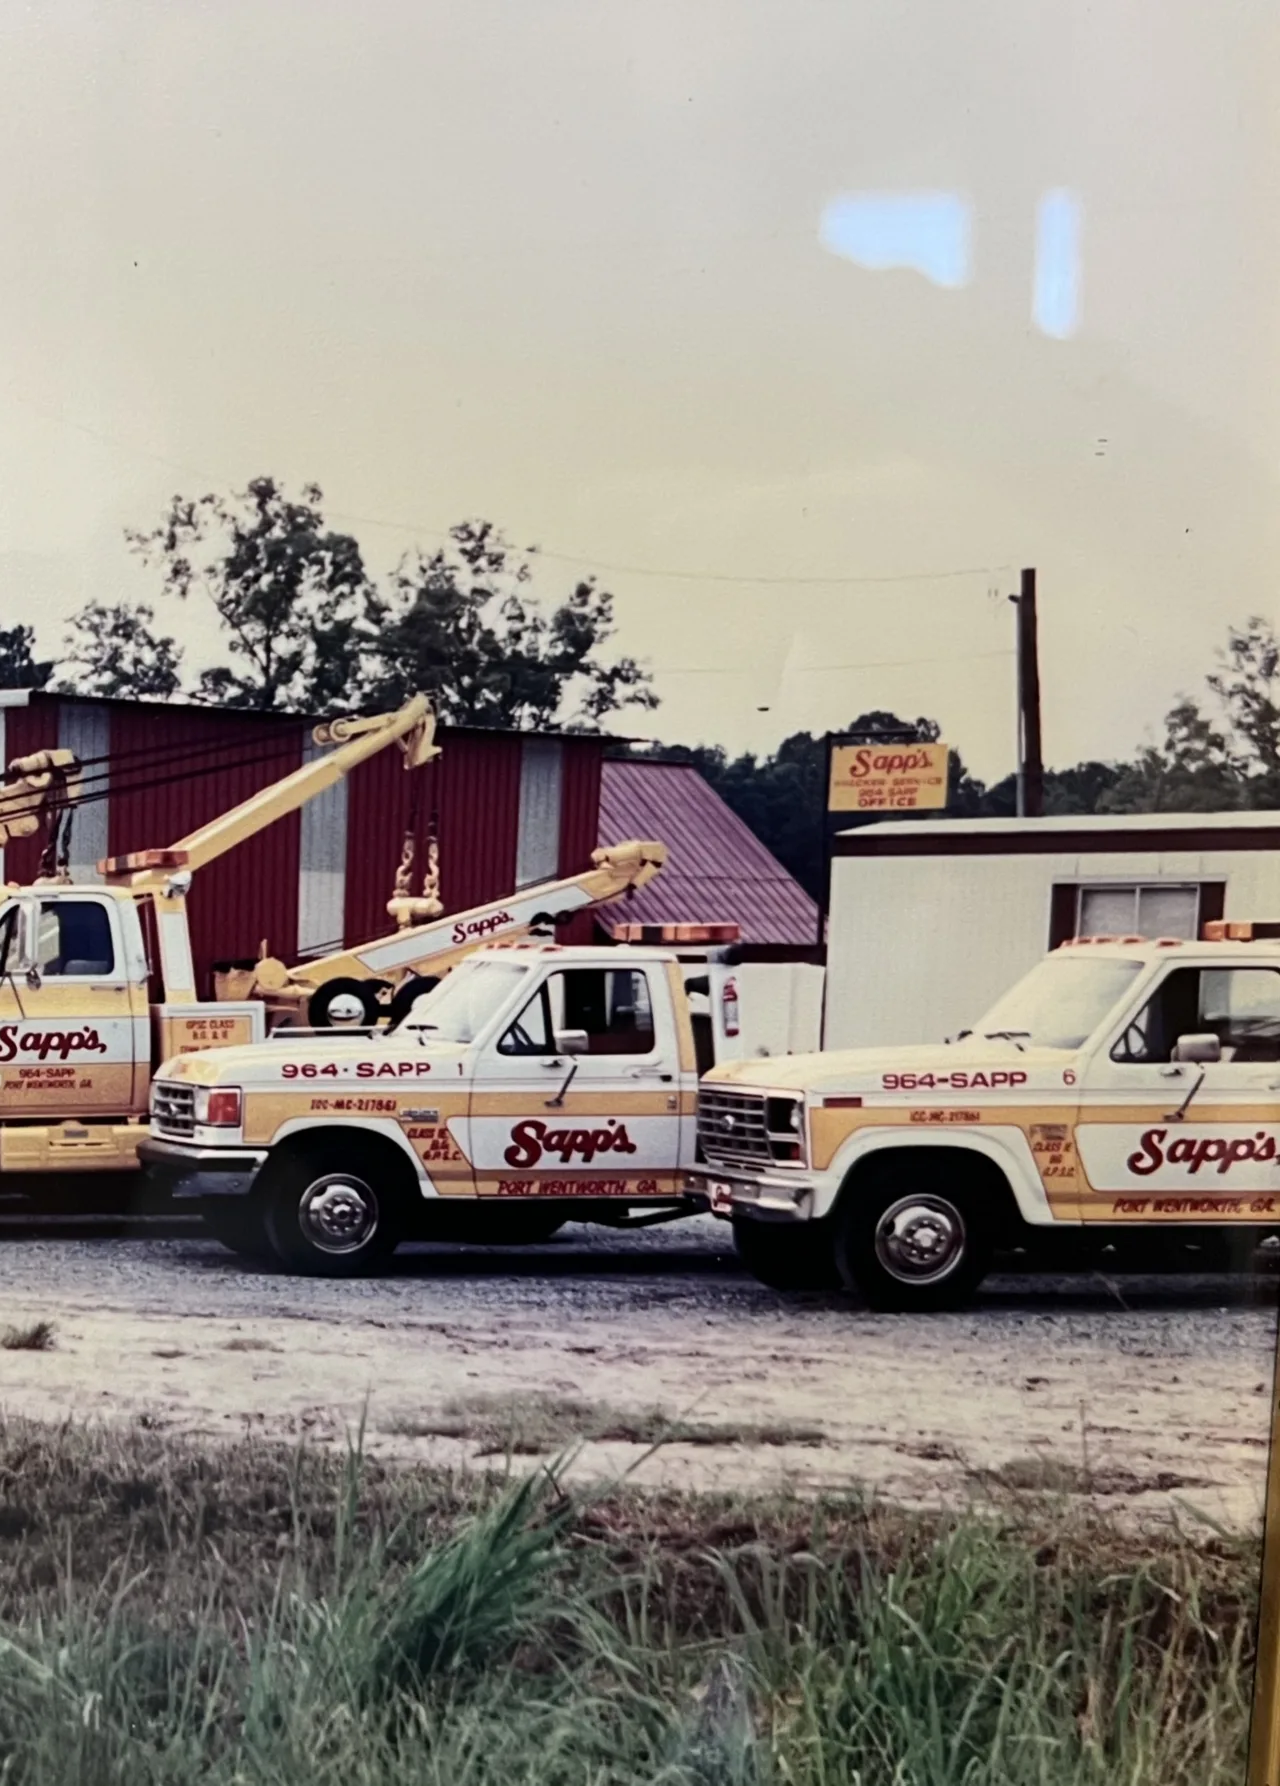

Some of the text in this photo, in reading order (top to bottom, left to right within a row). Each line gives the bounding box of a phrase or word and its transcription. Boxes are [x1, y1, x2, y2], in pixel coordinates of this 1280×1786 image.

[850, 748, 933, 777] Sapp's
[858, 798, 917, 807] OFFICE
[452, 911, 514, 943] Sapp's
[19, 1068, 75, 1078] 964-SAPP
[882, 1069, 1075, 1089] 964-SAPP 6
[504, 1119, 637, 1168] Sapp's
[1127, 1129, 1279, 1175] Sapp's
[498, 1181, 533, 1195] PORT
[1112, 1198, 1151, 1213] PORT
